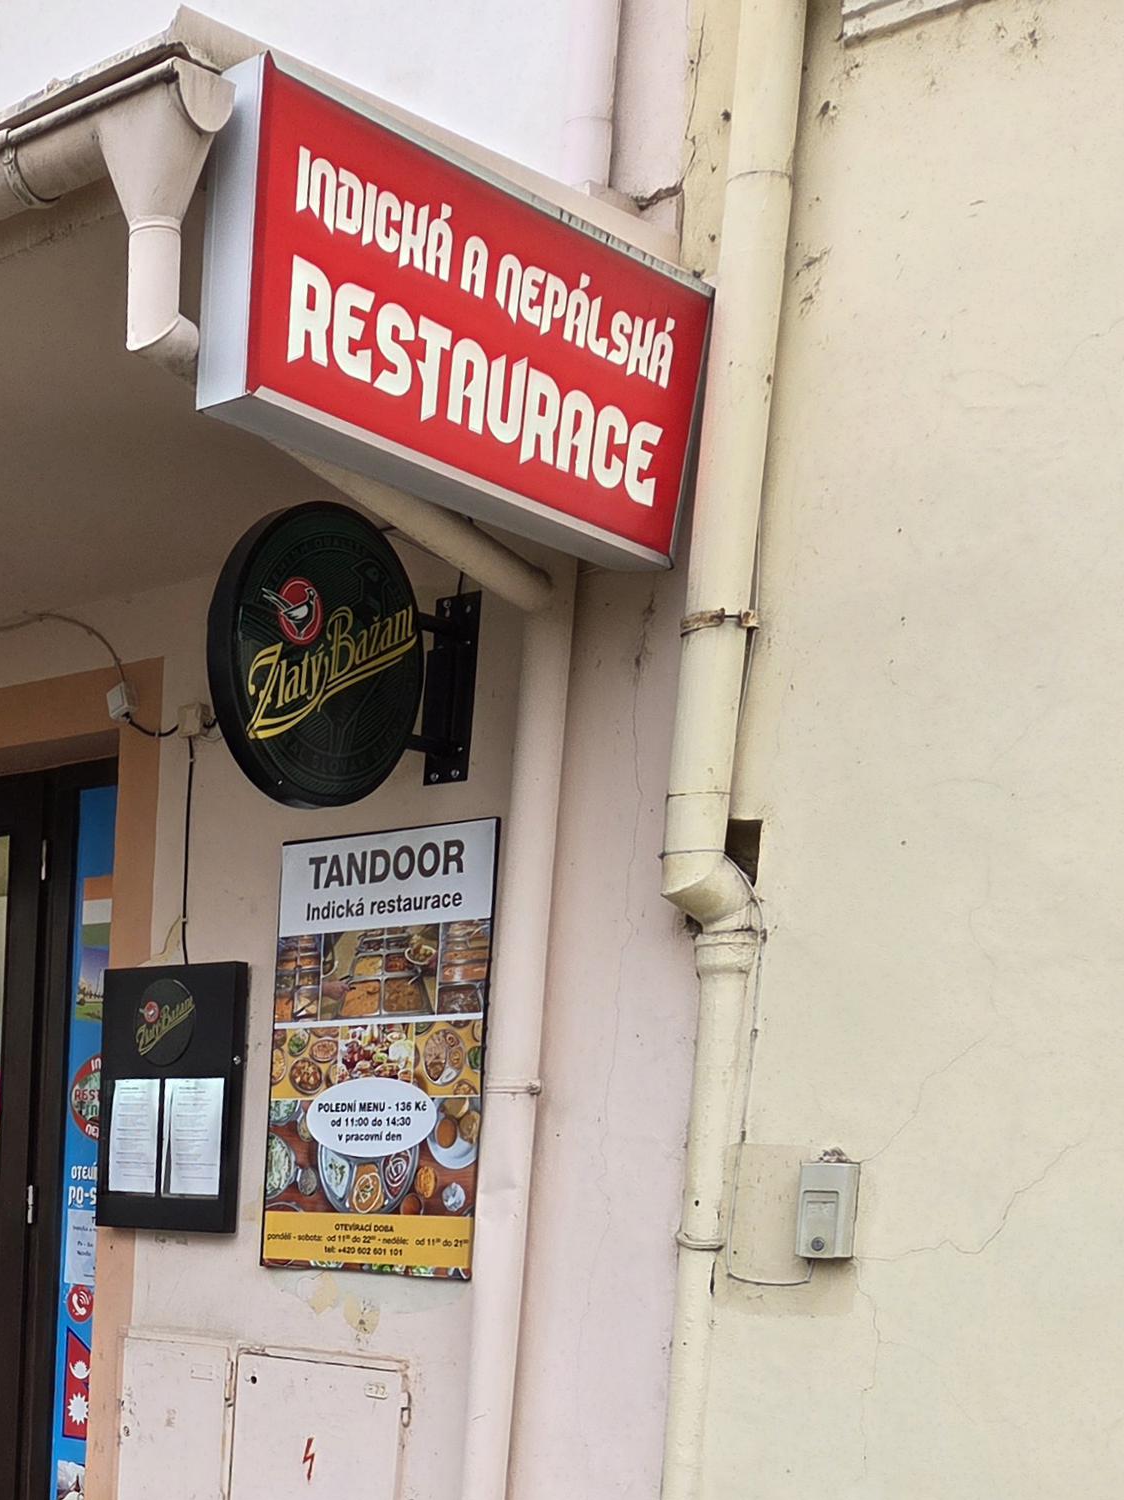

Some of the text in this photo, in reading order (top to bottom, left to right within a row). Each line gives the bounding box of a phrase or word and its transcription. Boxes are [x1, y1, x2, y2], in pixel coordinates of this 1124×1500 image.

[295, 145, 676, 389] INDICKÁ A NEPÁLSKÁ
[287, 254, 664, 507] RESTAURACE
[308, 839, 465, 890] TANDOOR
[306, 891, 463, 921] Indická restaurace
[317, 1099, 356, 1113] POLEDNÍ
[358, 1102, 386, 1112] MENU
[414, 1101, 427, 1112] Kč
[330, 1117, 411, 1127] od 11:00 do 14:30
[345, 1131, 383, 1143] pracovní
[385, 1131, 402, 1141] den
[334, 1223, 394, 1233] OTEVÍRACÍ DOBA
[326, 1234, 336, 1242] od
[352, 1235, 361, 1243] do
[415, 1238, 425, 1246] od
[442, 1239, 453, 1247] do
[338, 1246, 355, 1254] +420
[357, 1247, 371, 1255] 602
[389, 1248, 403, 1256] 101
